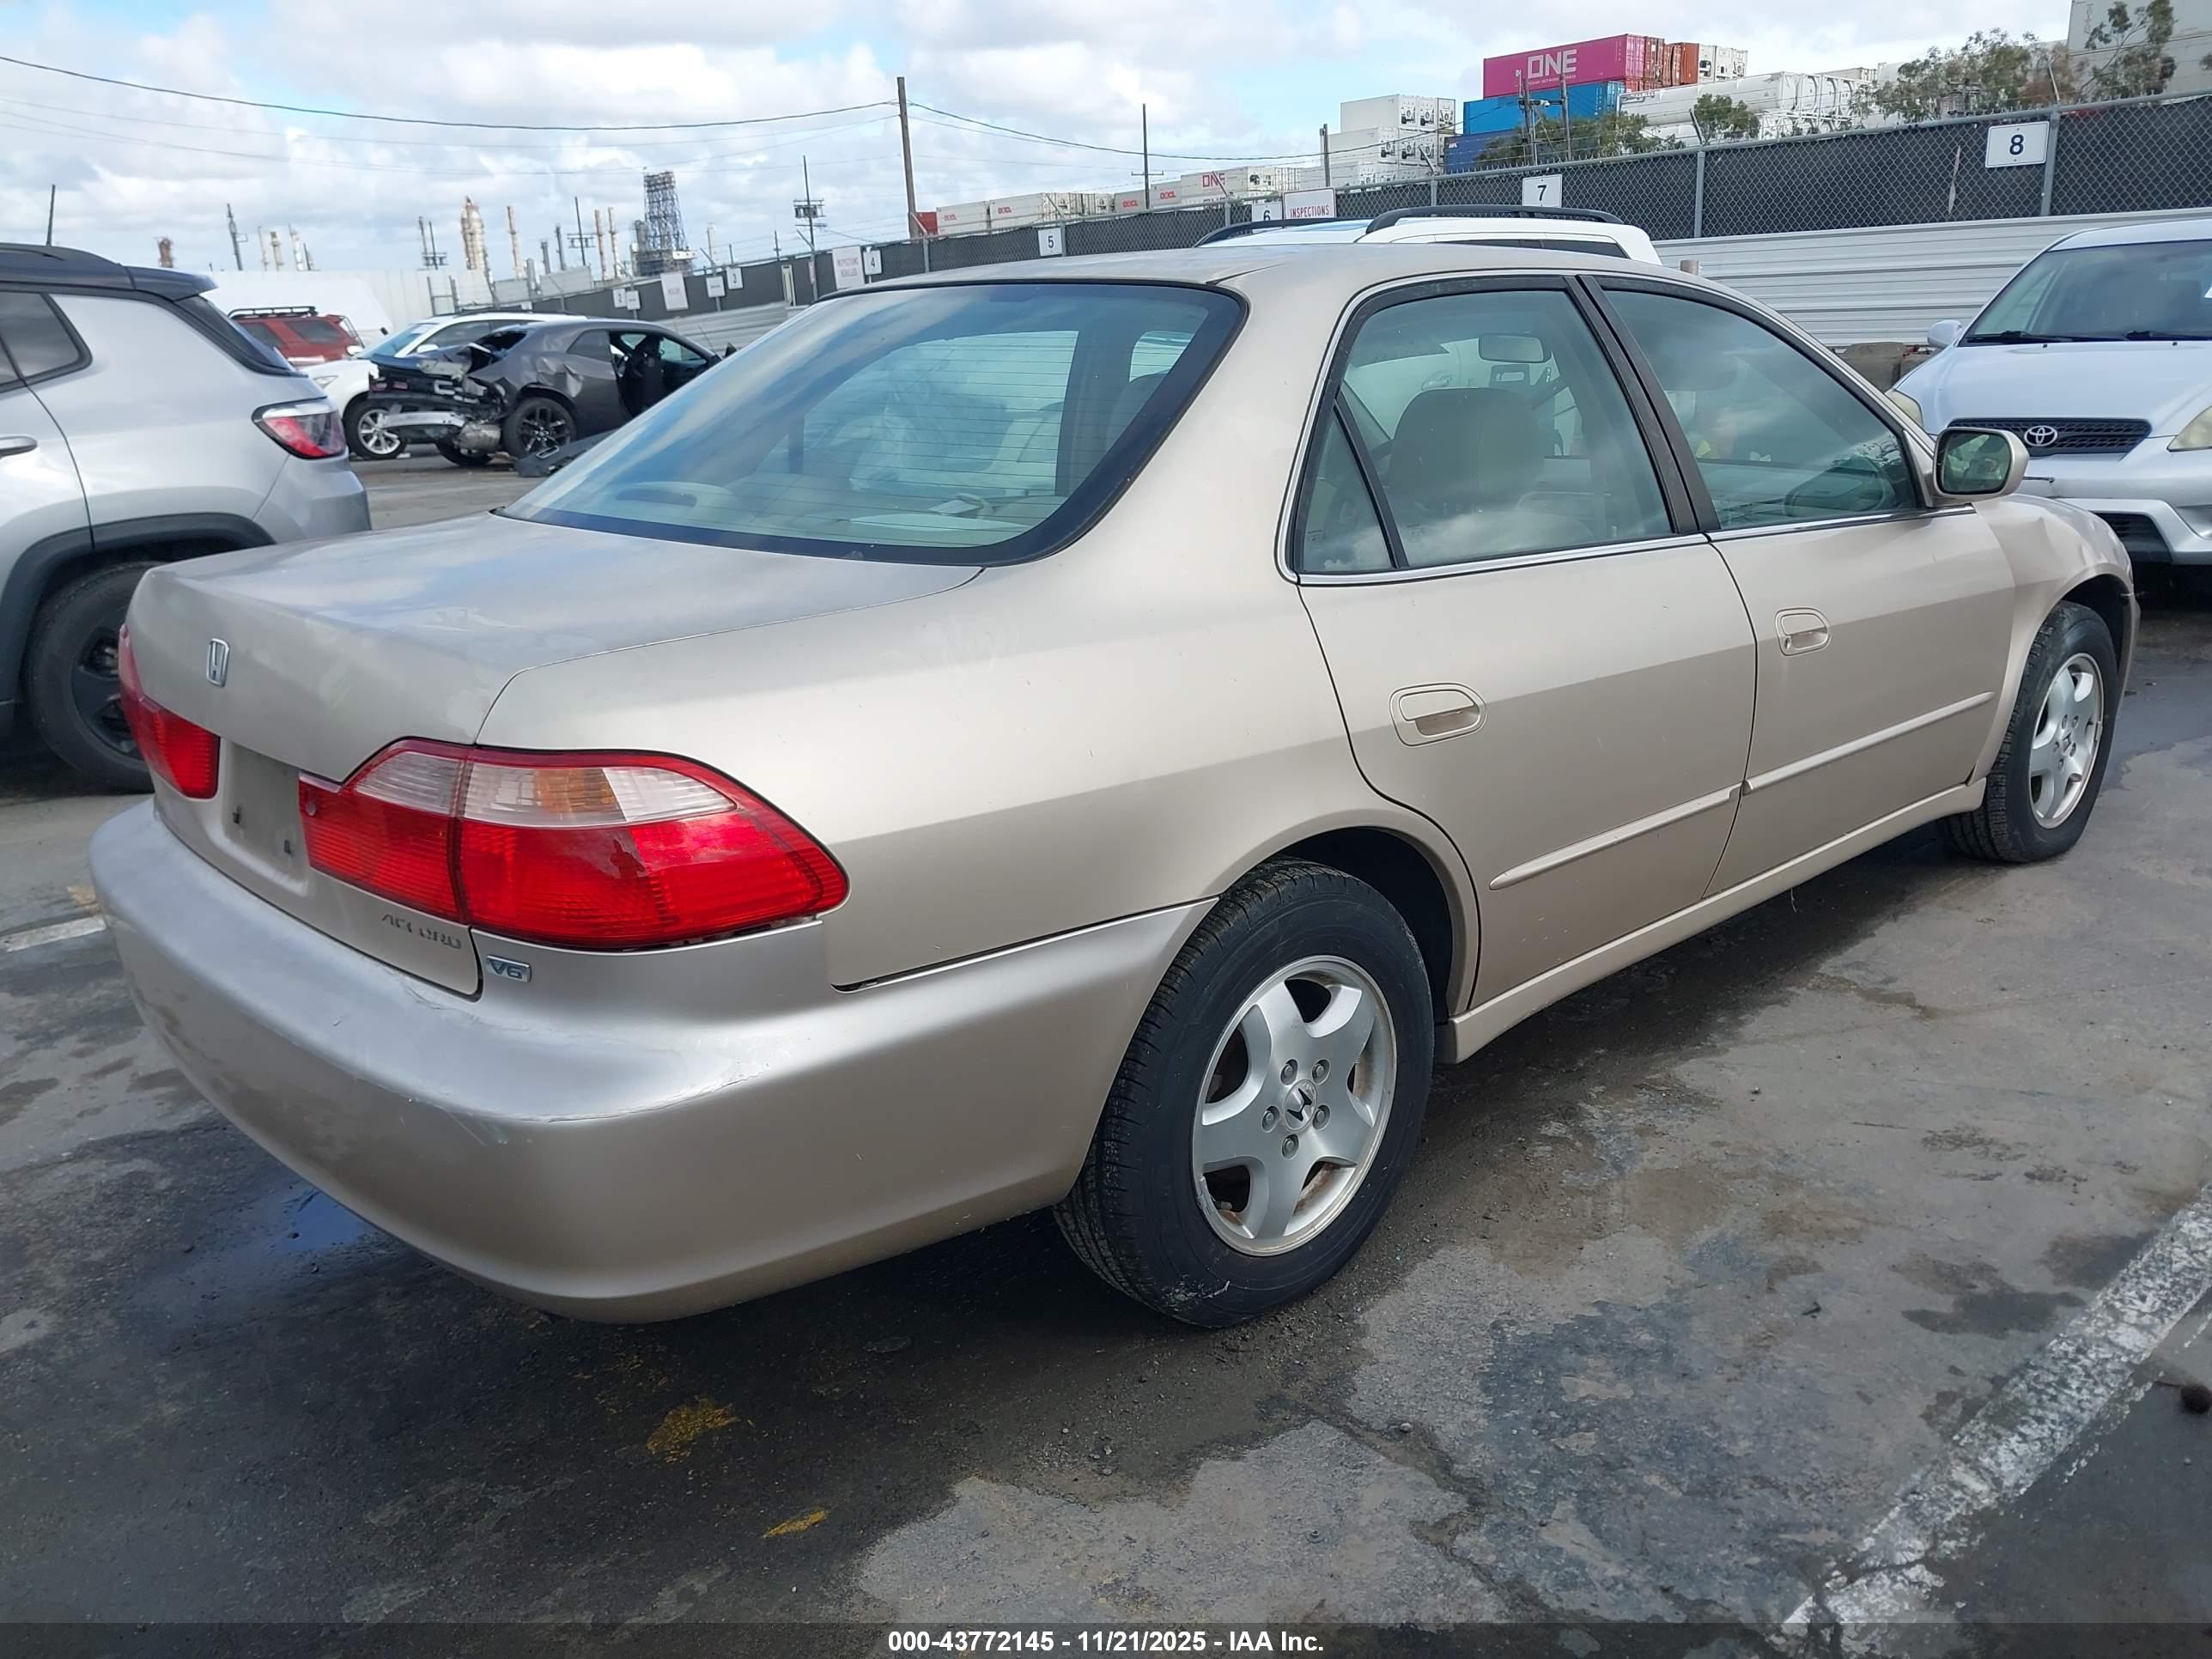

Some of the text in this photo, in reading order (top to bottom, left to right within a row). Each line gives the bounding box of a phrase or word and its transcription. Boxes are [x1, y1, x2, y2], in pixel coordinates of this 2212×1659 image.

[1528, 49, 1577, 79] ONE
[2009, 134, 2024, 155] 8
[1537, 185, 1547, 201] 7
[1290, 204, 1330, 218] INSPECTIONS
[1048, 235, 1054, 249] 5
[871, 257, 876, 269] 4
[489, 959, 523, 980] V6
